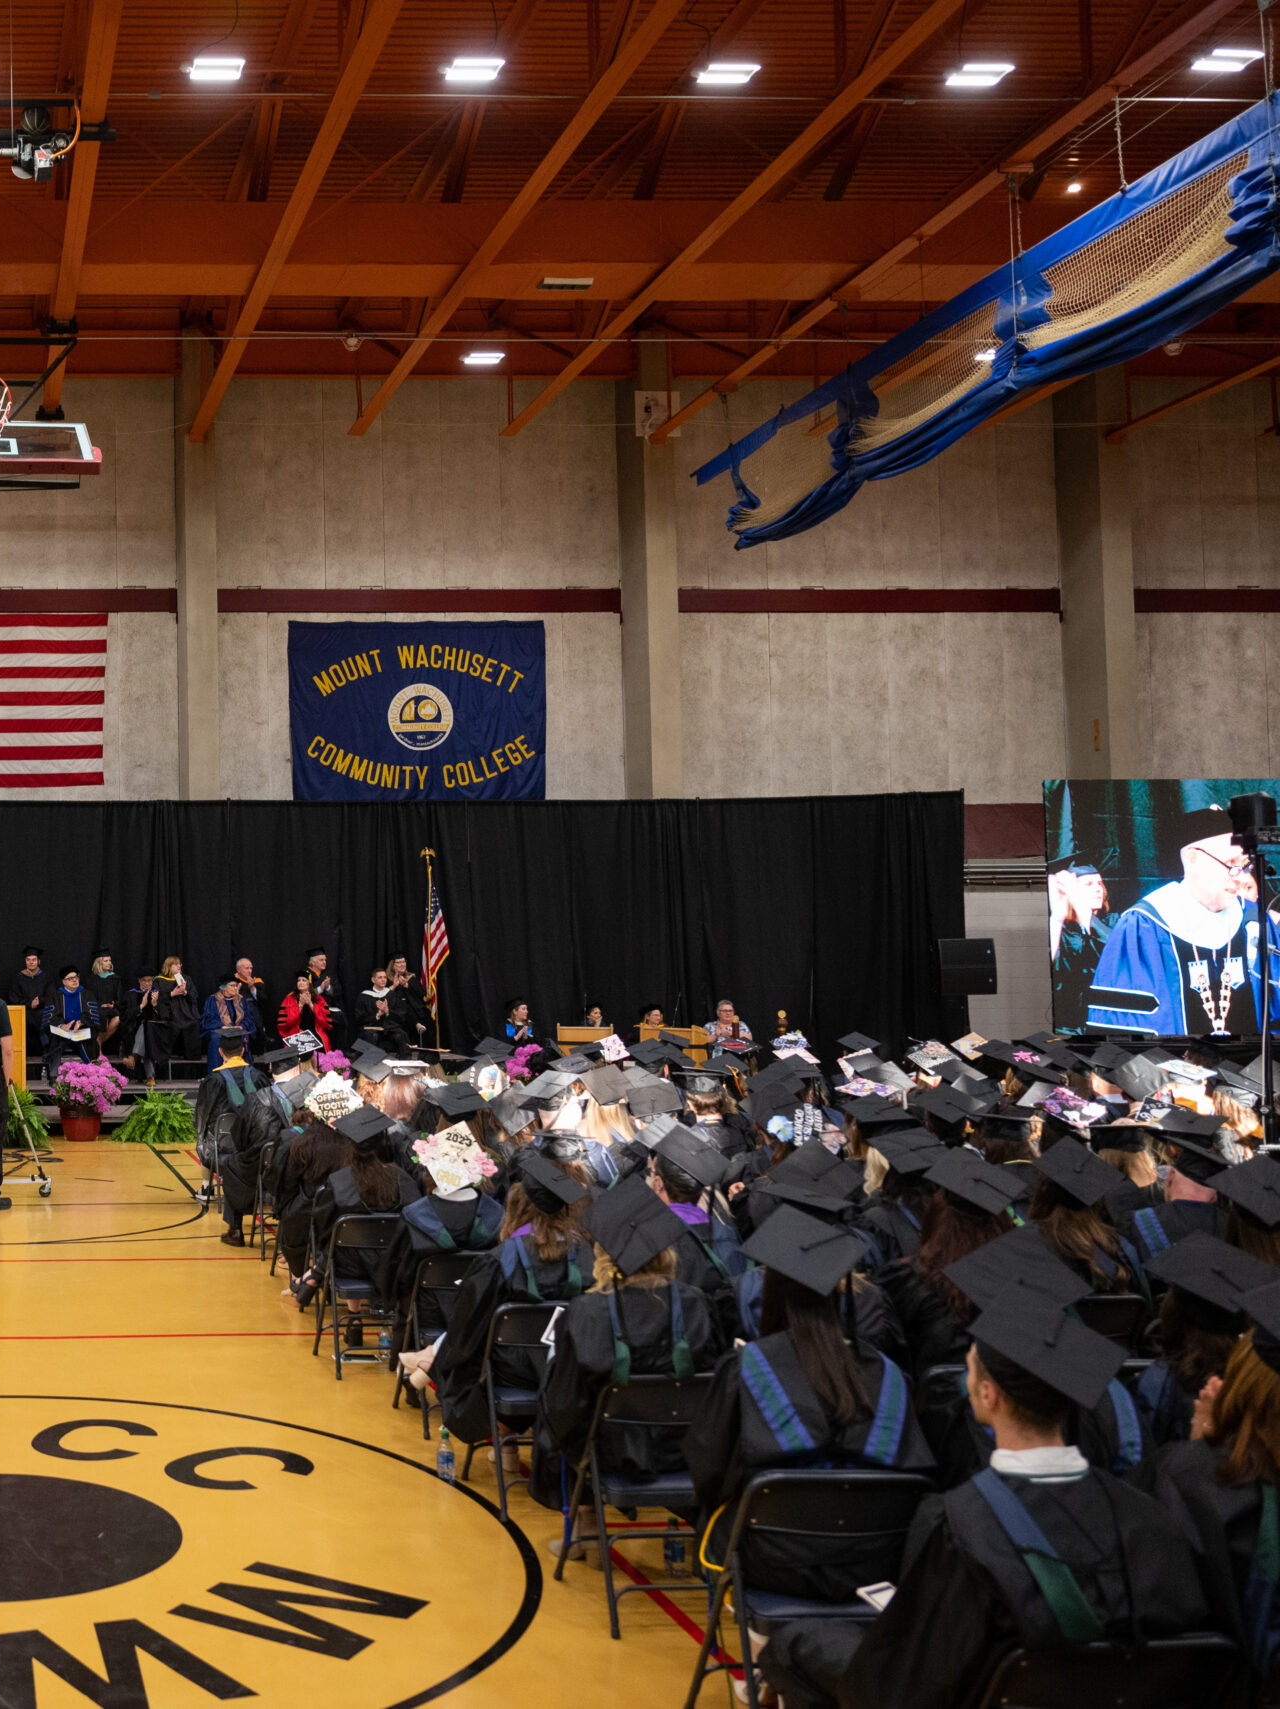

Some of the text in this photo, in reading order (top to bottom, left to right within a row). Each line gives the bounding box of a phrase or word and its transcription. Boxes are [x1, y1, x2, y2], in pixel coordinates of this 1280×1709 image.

[312, 644, 524, 697] MOUNT WACHUSETT
[307, 734, 535, 790] COMMUNITY COLLEGE
[316, 1092, 350, 1103] OFFICIA
[320, 1101, 348, 1110] TOOTH
[446, 1132, 473, 1147] 2023
